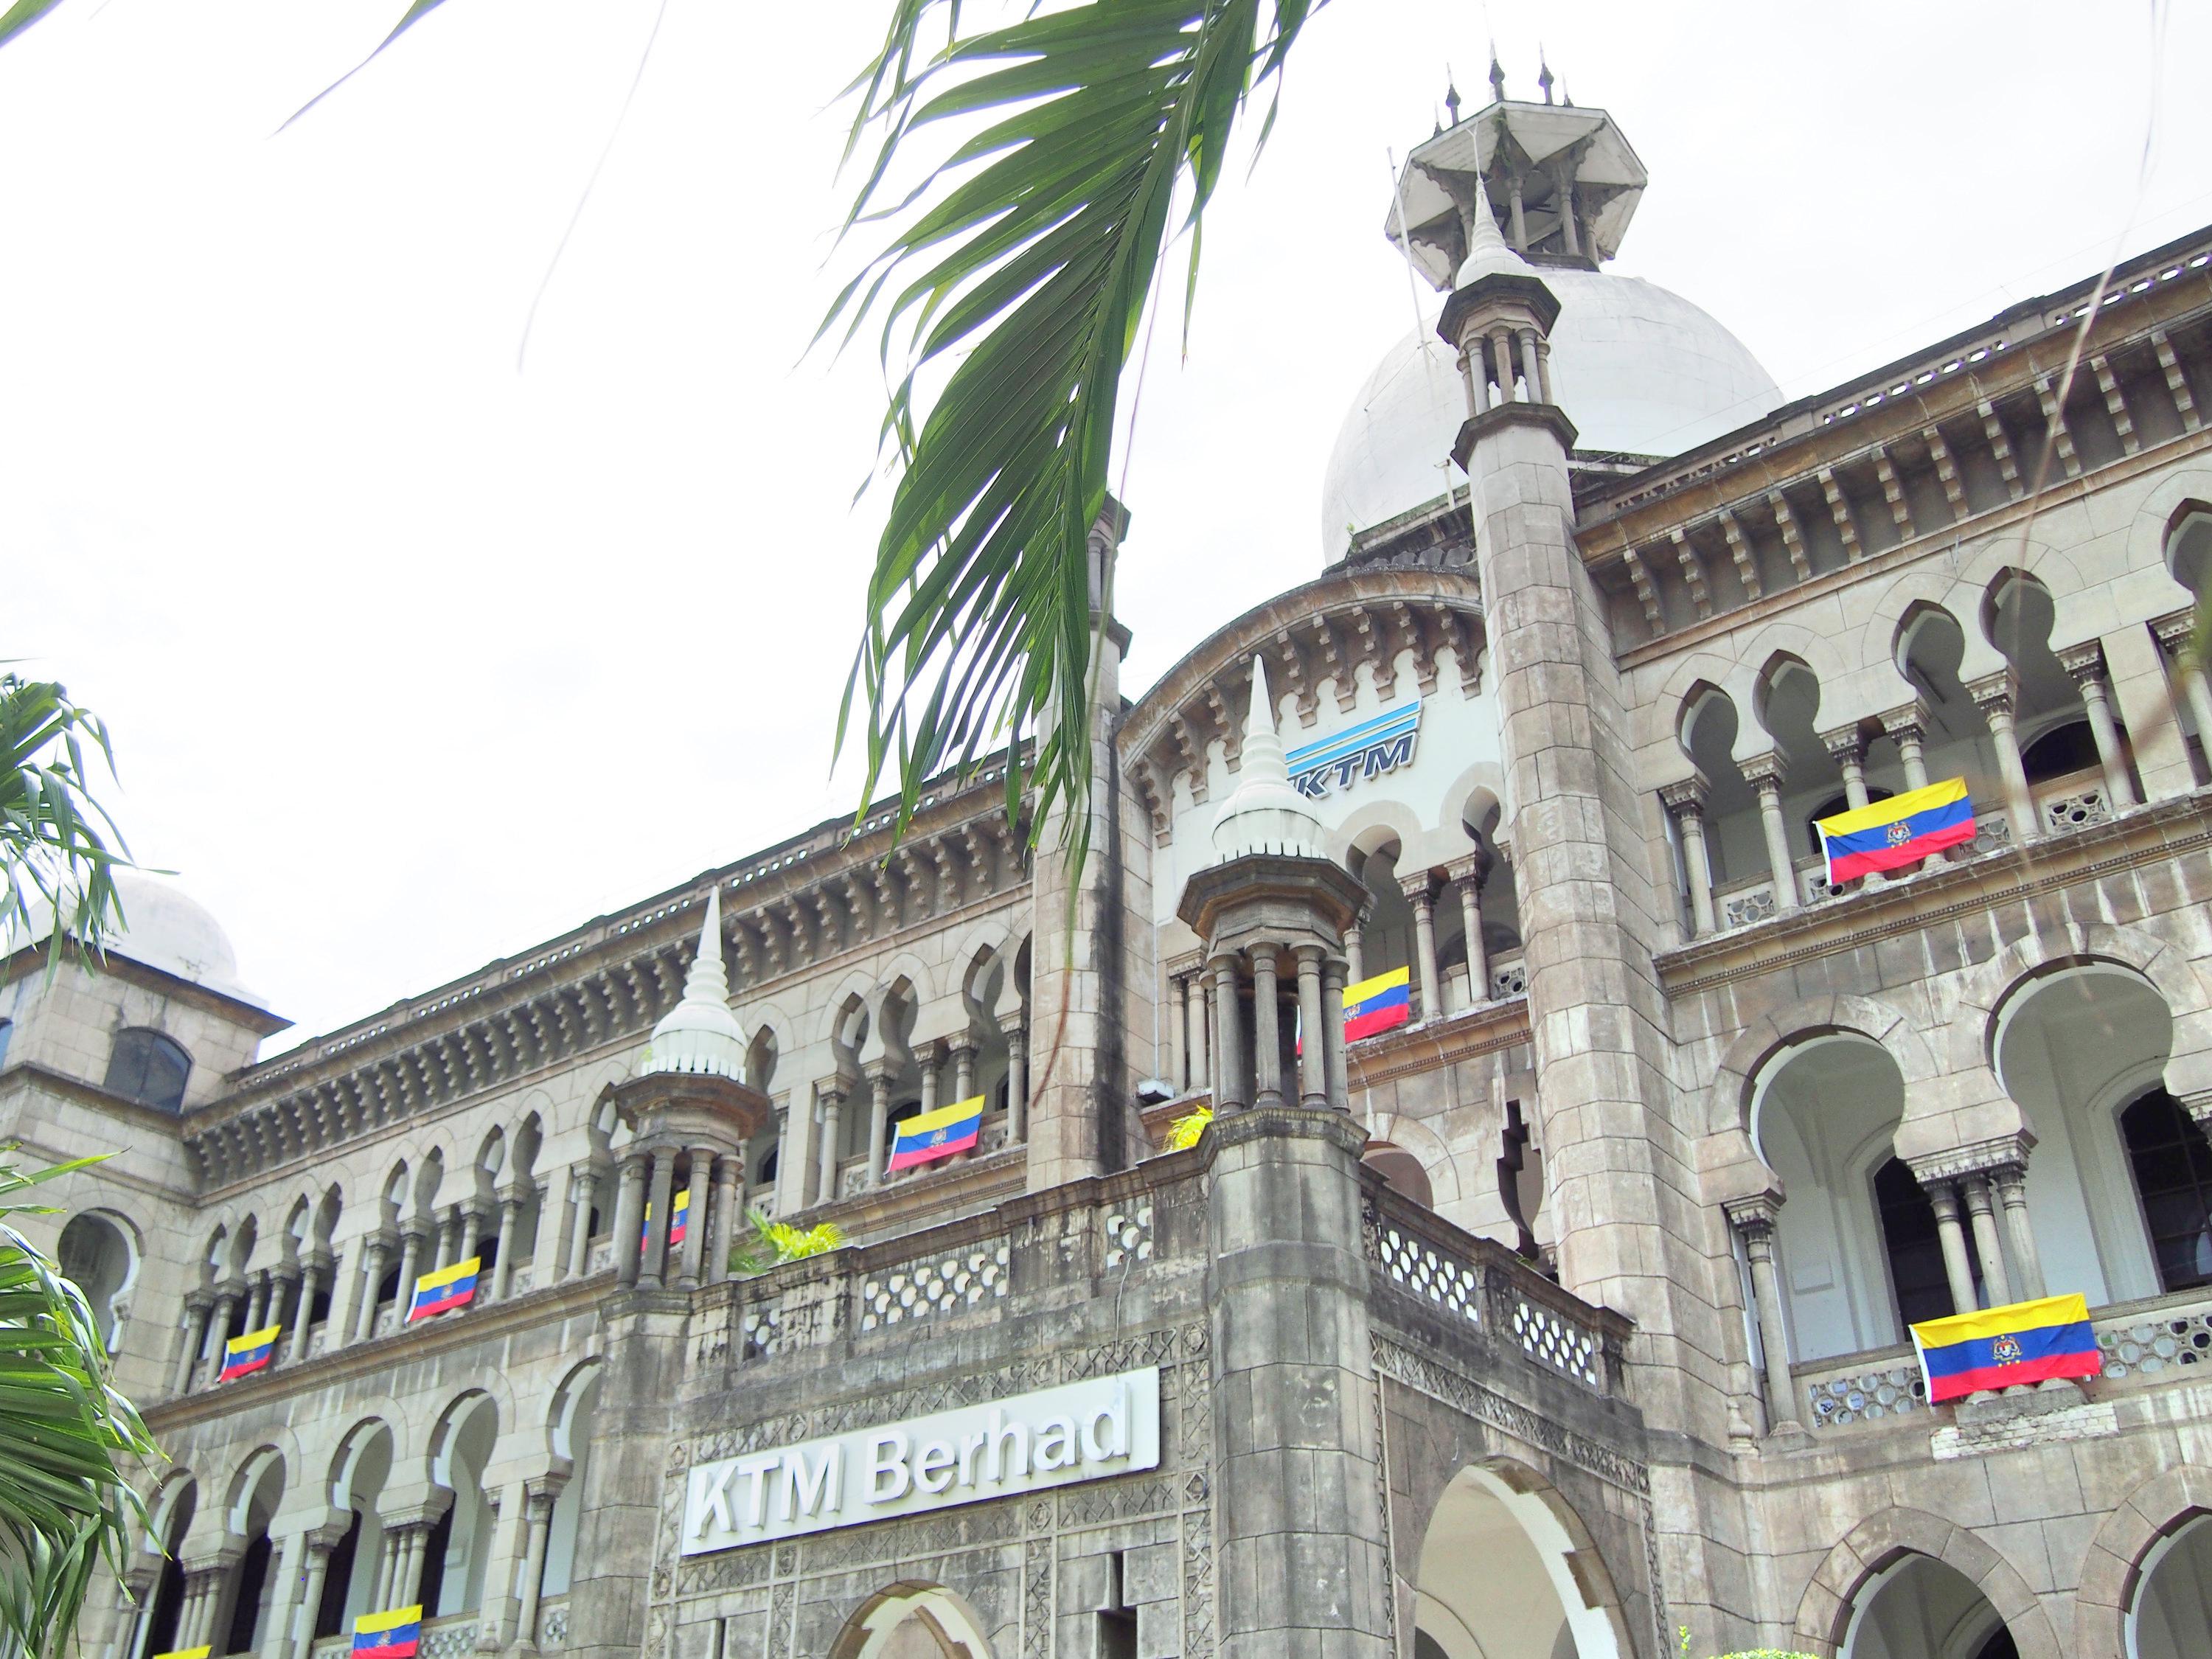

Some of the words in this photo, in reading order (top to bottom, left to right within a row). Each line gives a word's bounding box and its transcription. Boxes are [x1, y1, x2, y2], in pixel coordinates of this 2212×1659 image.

[1295, 733, 1419, 799] KTM
[692, 1443, 844, 1539] KTM
[864, 1381, 1130, 1506] Berhad
